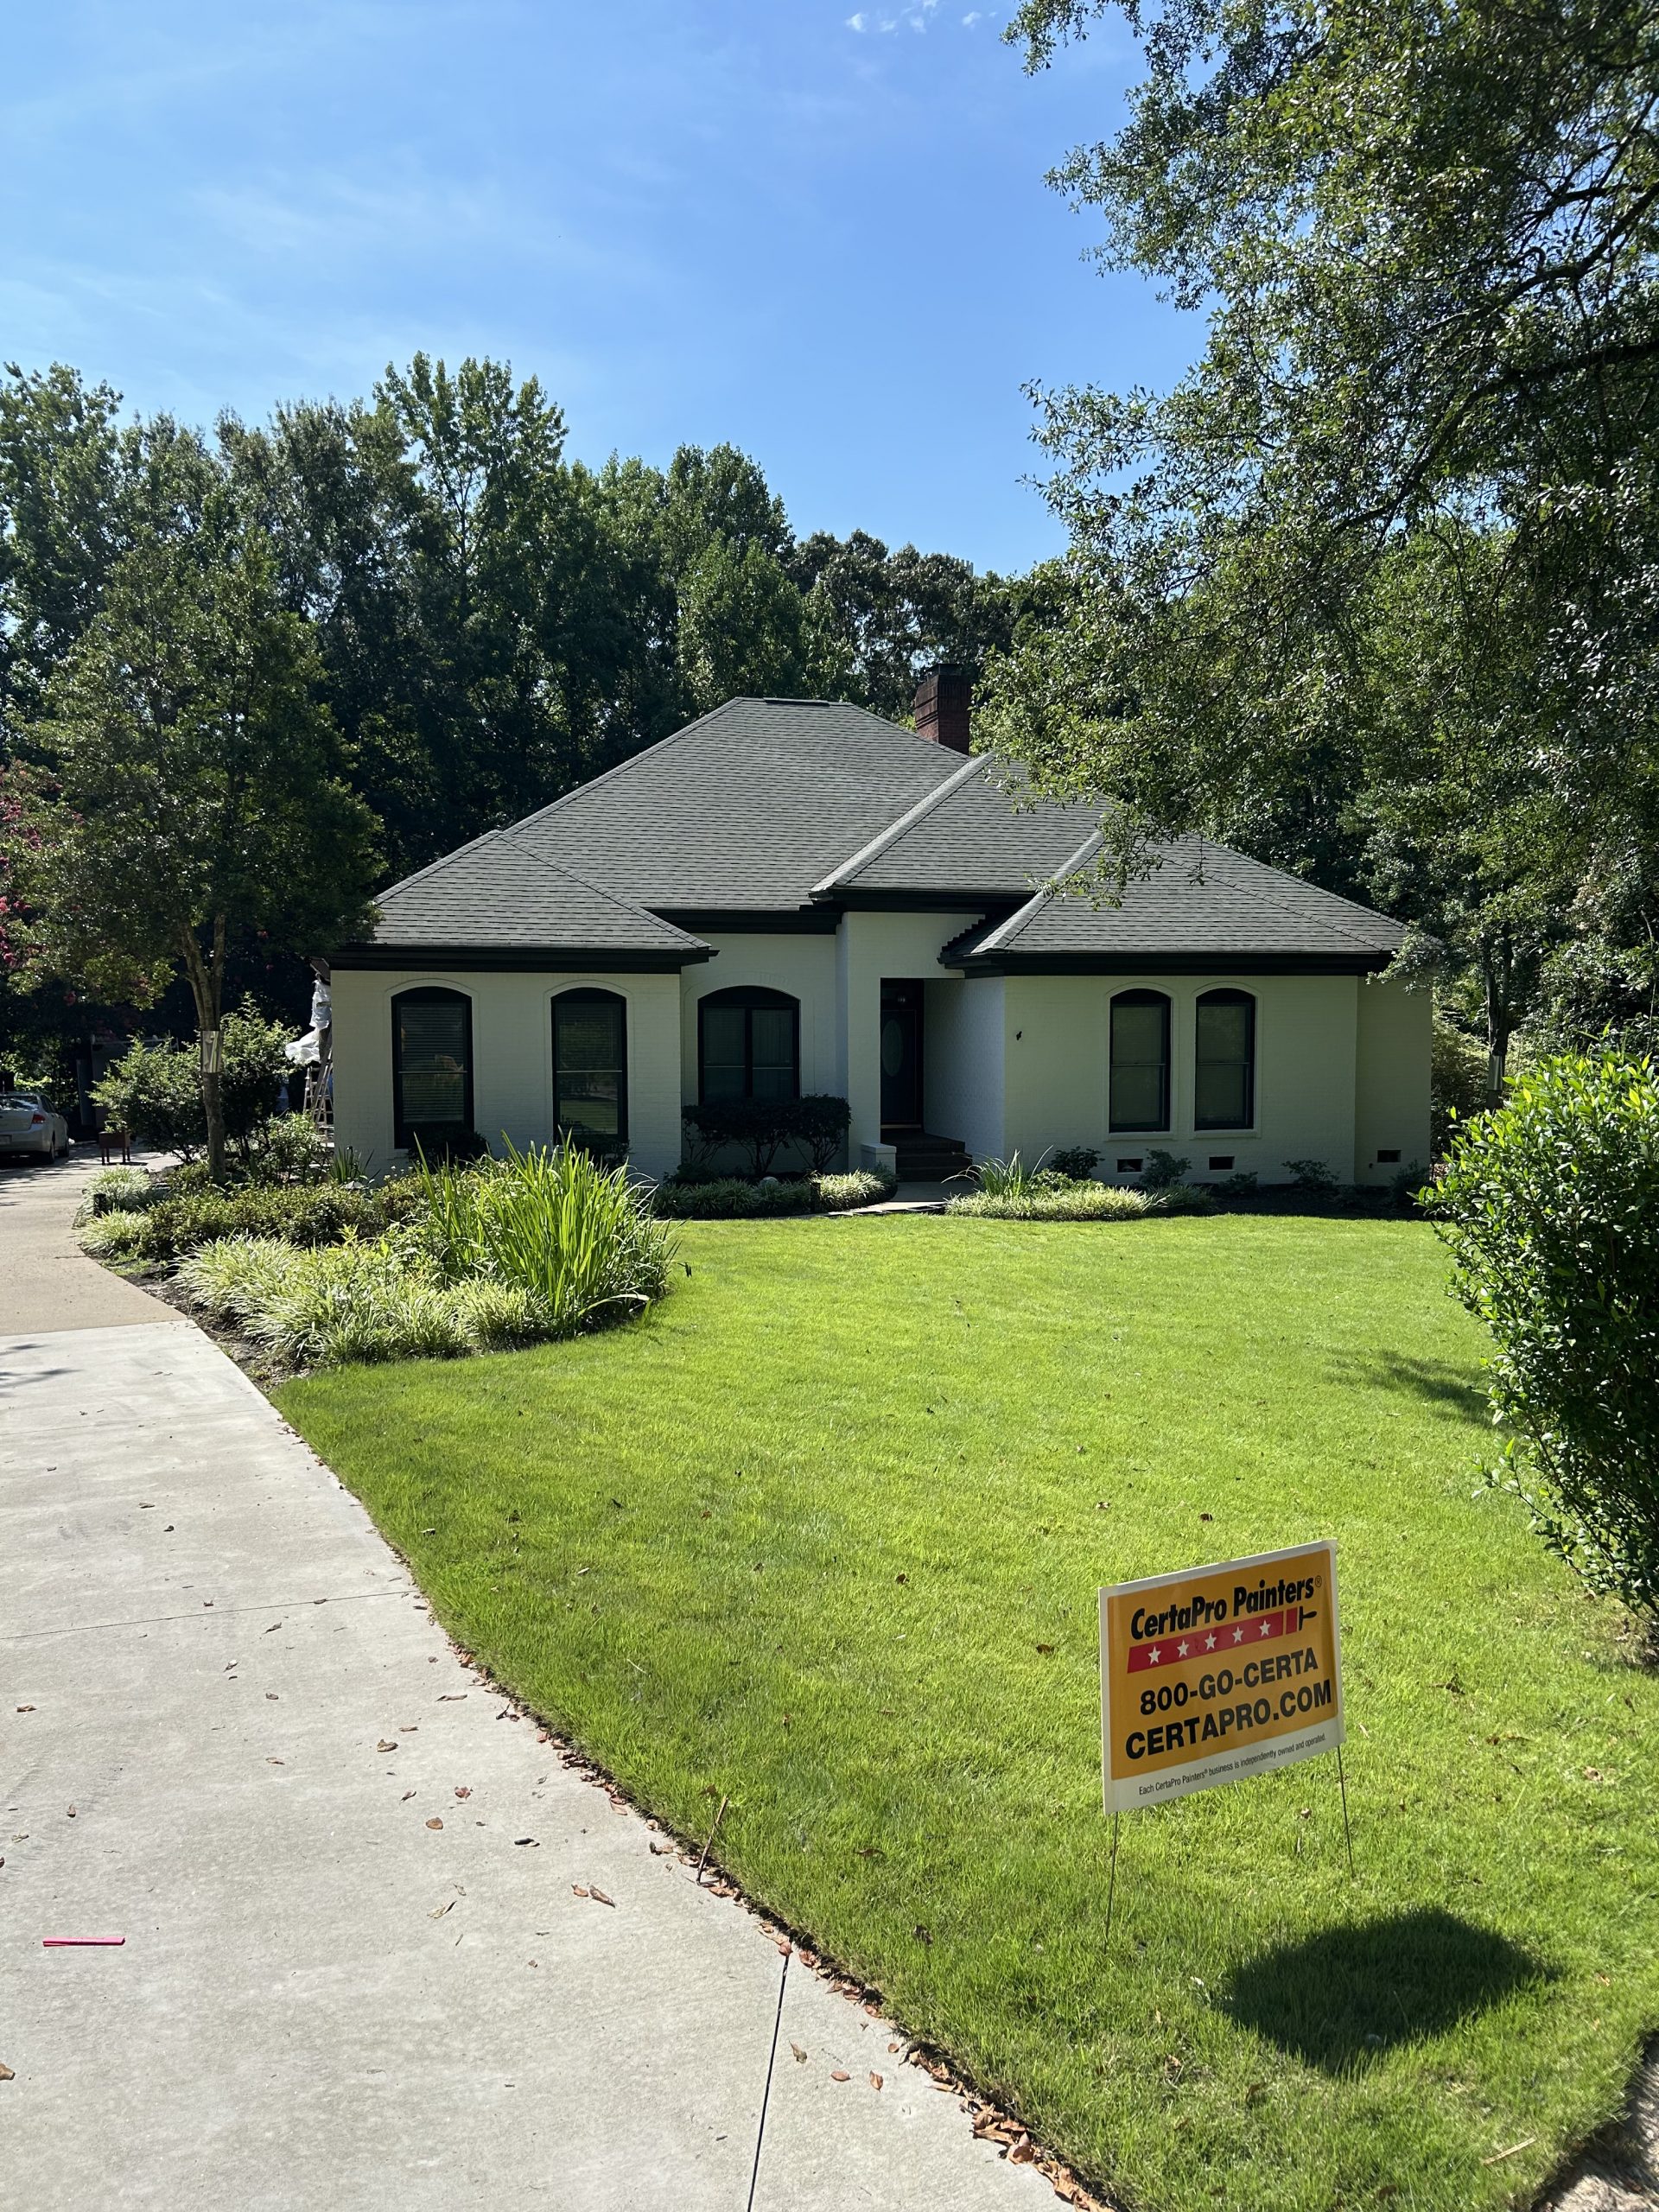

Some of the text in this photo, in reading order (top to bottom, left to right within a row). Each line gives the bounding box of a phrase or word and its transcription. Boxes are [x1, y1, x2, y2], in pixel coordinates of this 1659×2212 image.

[1131, 1596, 1227, 1640] CertaPro
[1141, 1647, 1319, 1715] 800-GO-CERTA
[1126, 1679, 1332, 1759] CERTAPRO.COM
[1139, 1784, 1154, 1796] Each
[1155, 1778, 1181, 1791] CertaPro
[1209, 1762, 1233, 1776] business
[1234, 1760, 1240, 1770] is
[1241, 1750, 1276, 1767] independently
[1278, 1744, 1295, 1756] owned
[1295, 1740, 1305, 1751] and
